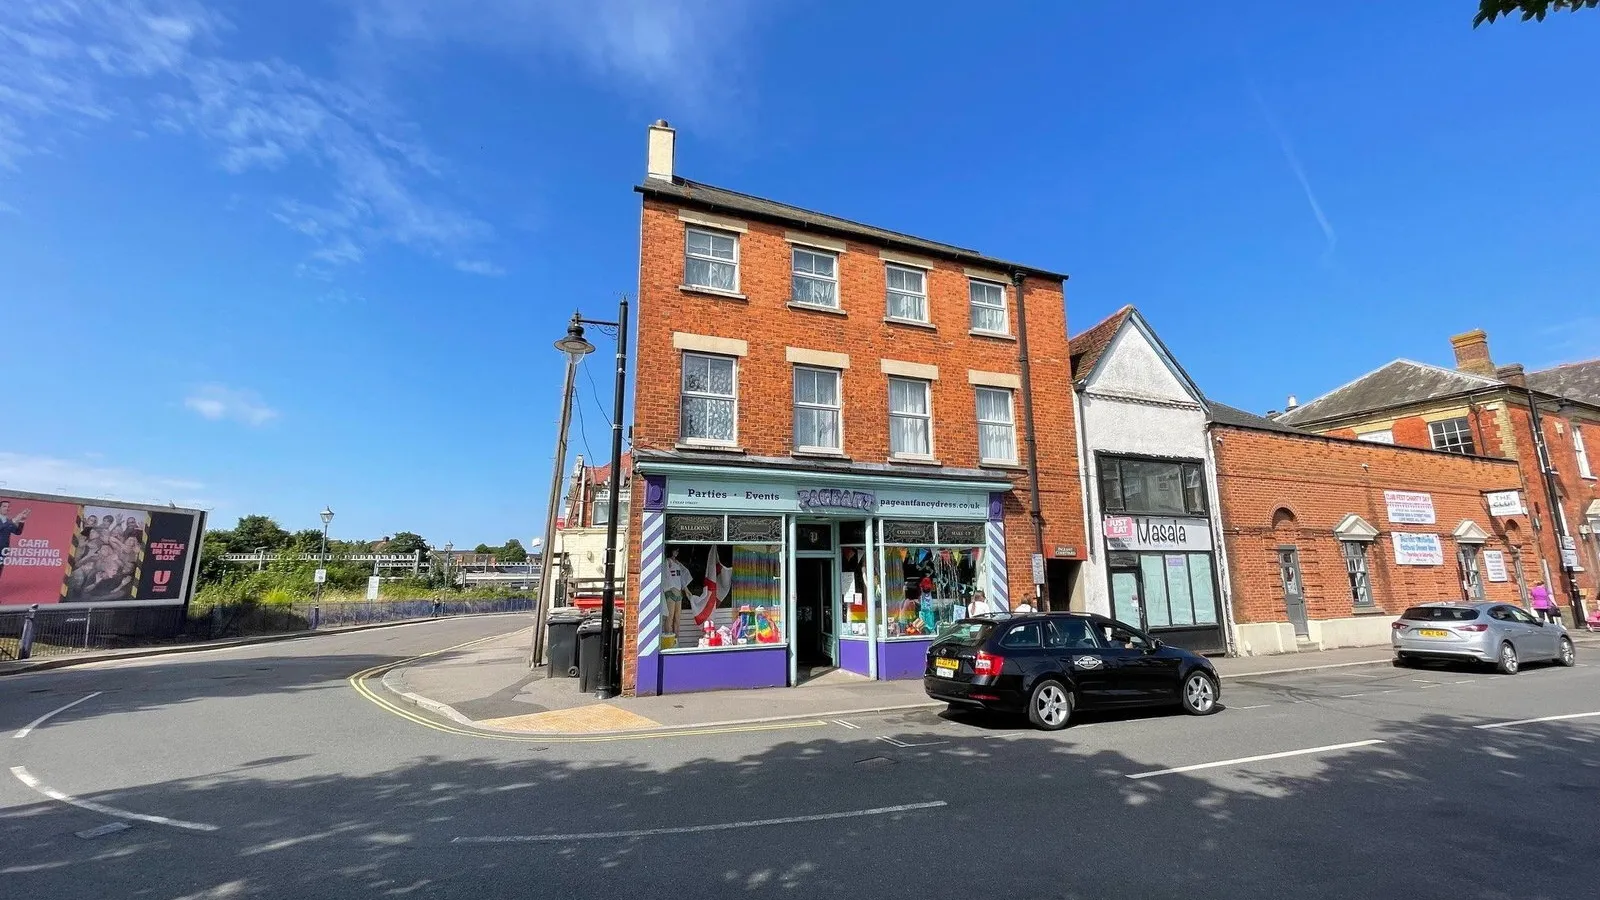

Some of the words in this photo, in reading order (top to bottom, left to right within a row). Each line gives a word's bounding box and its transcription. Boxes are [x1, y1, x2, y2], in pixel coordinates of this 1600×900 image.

[687, 488, 727, 499] Parties
[745, 491, 780, 501] Events
[797, 488, 876, 511] PAGEANT
[880, 498, 980, 510] pageantfancydress.co.uk
[1493, 500, 1517, 508] CLUB
[1107, 519, 1127, 527] JUST
[1113, 526, 1128, 534] EAT
[1136, 518, 1187, 546] Masala
[18, 538, 49, 549] CARR
[1, 547, 60, 557] CRUSHING
[153, 570, 171, 585] U
